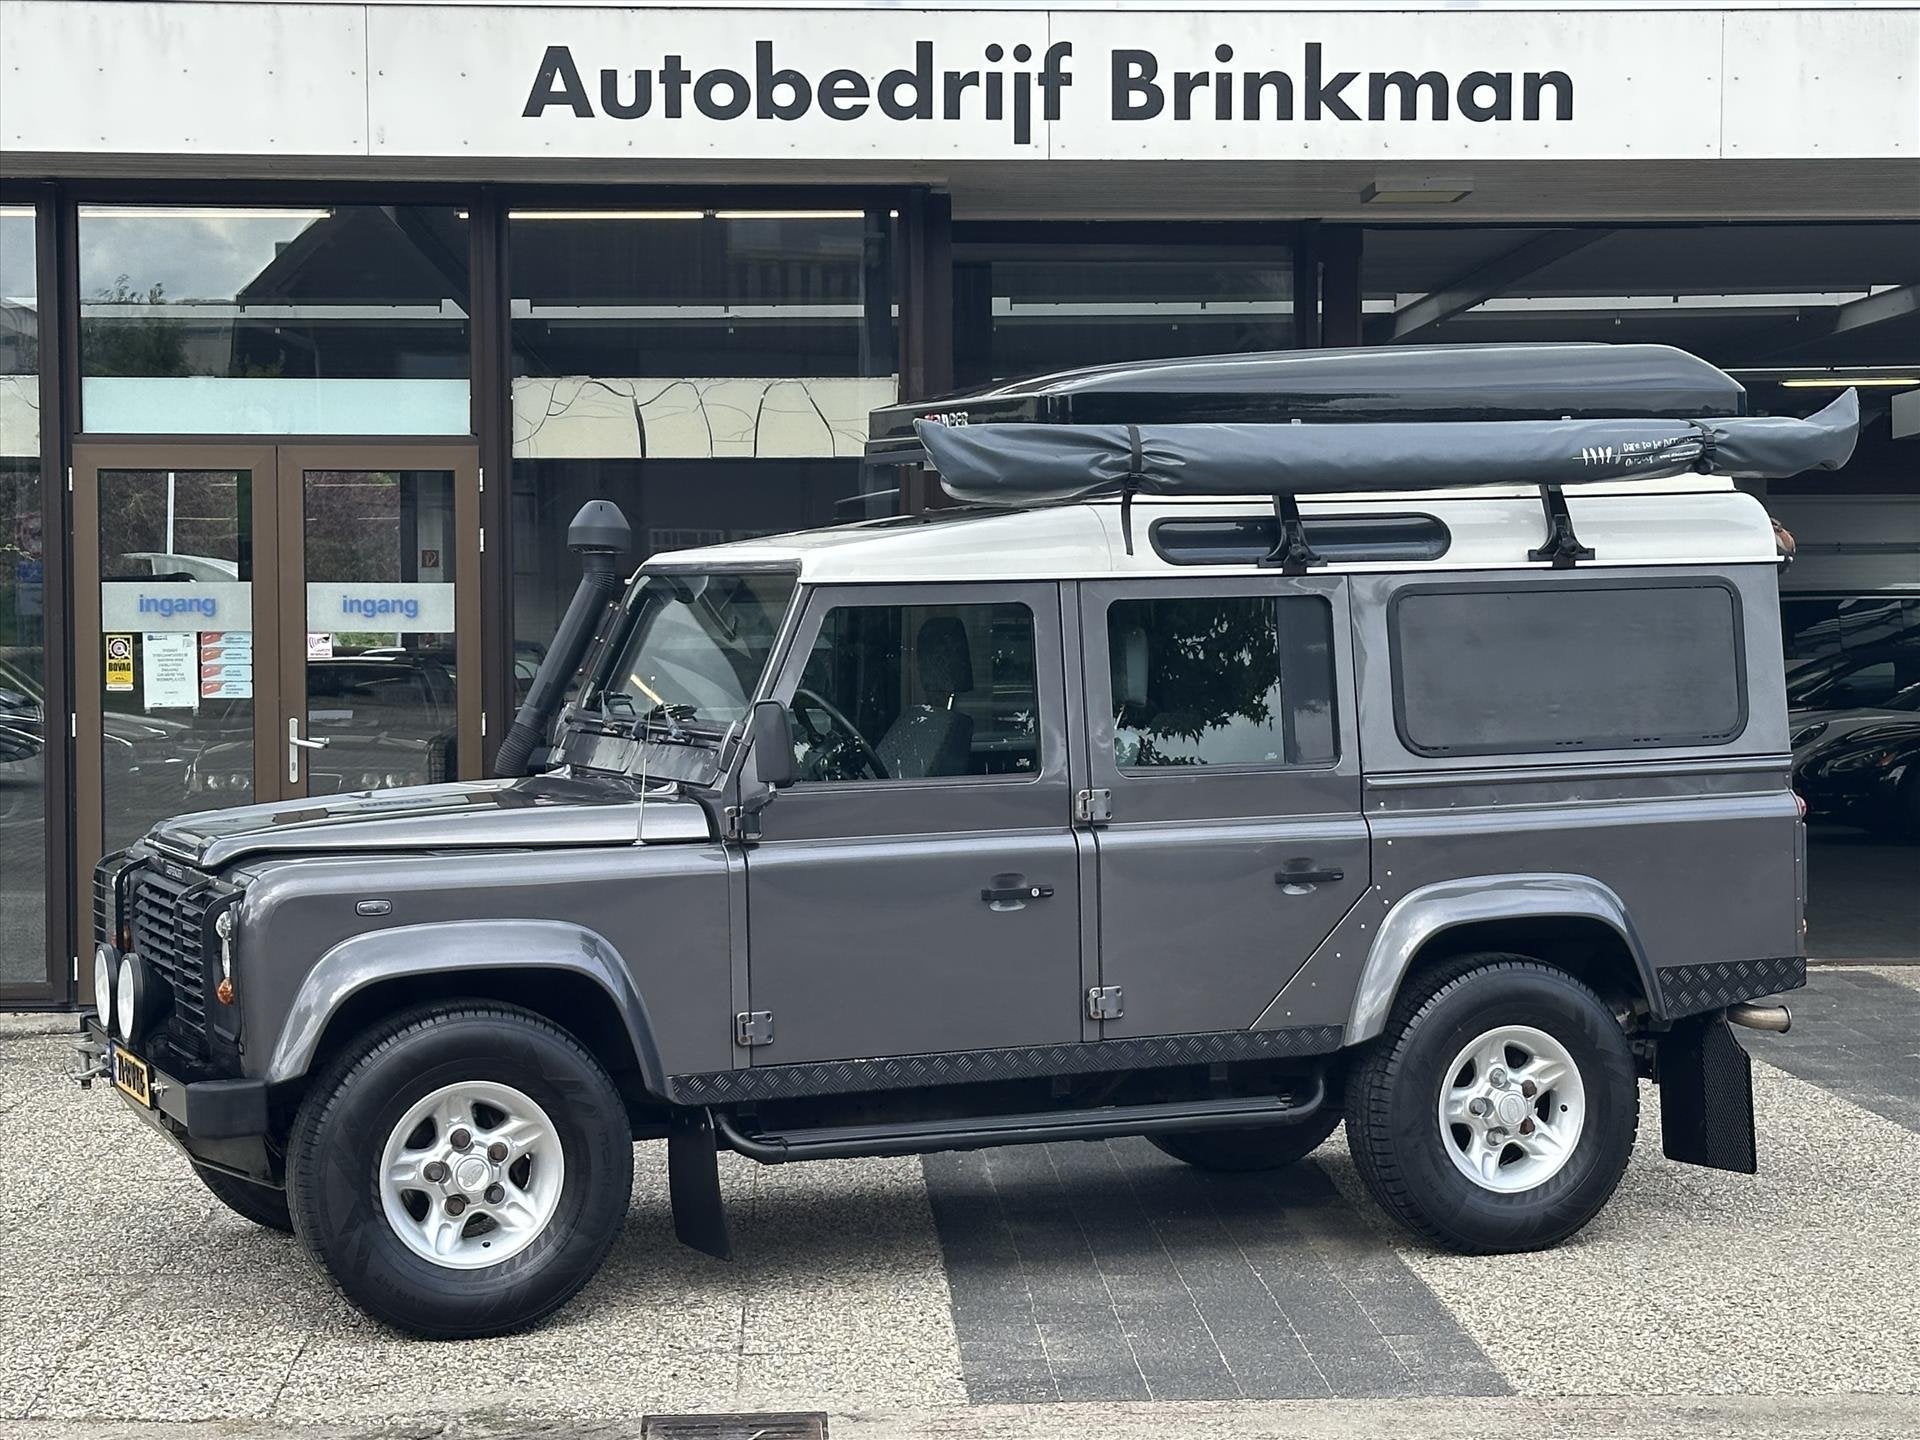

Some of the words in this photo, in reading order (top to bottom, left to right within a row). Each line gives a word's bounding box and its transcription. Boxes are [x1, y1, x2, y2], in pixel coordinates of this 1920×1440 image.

[521, 40, 1073, 144] Autobedrijf
[1111, 42, 1574, 123] Brinkman
[138, 594, 216, 617] ingang
[342, 595, 418, 617] ingang
